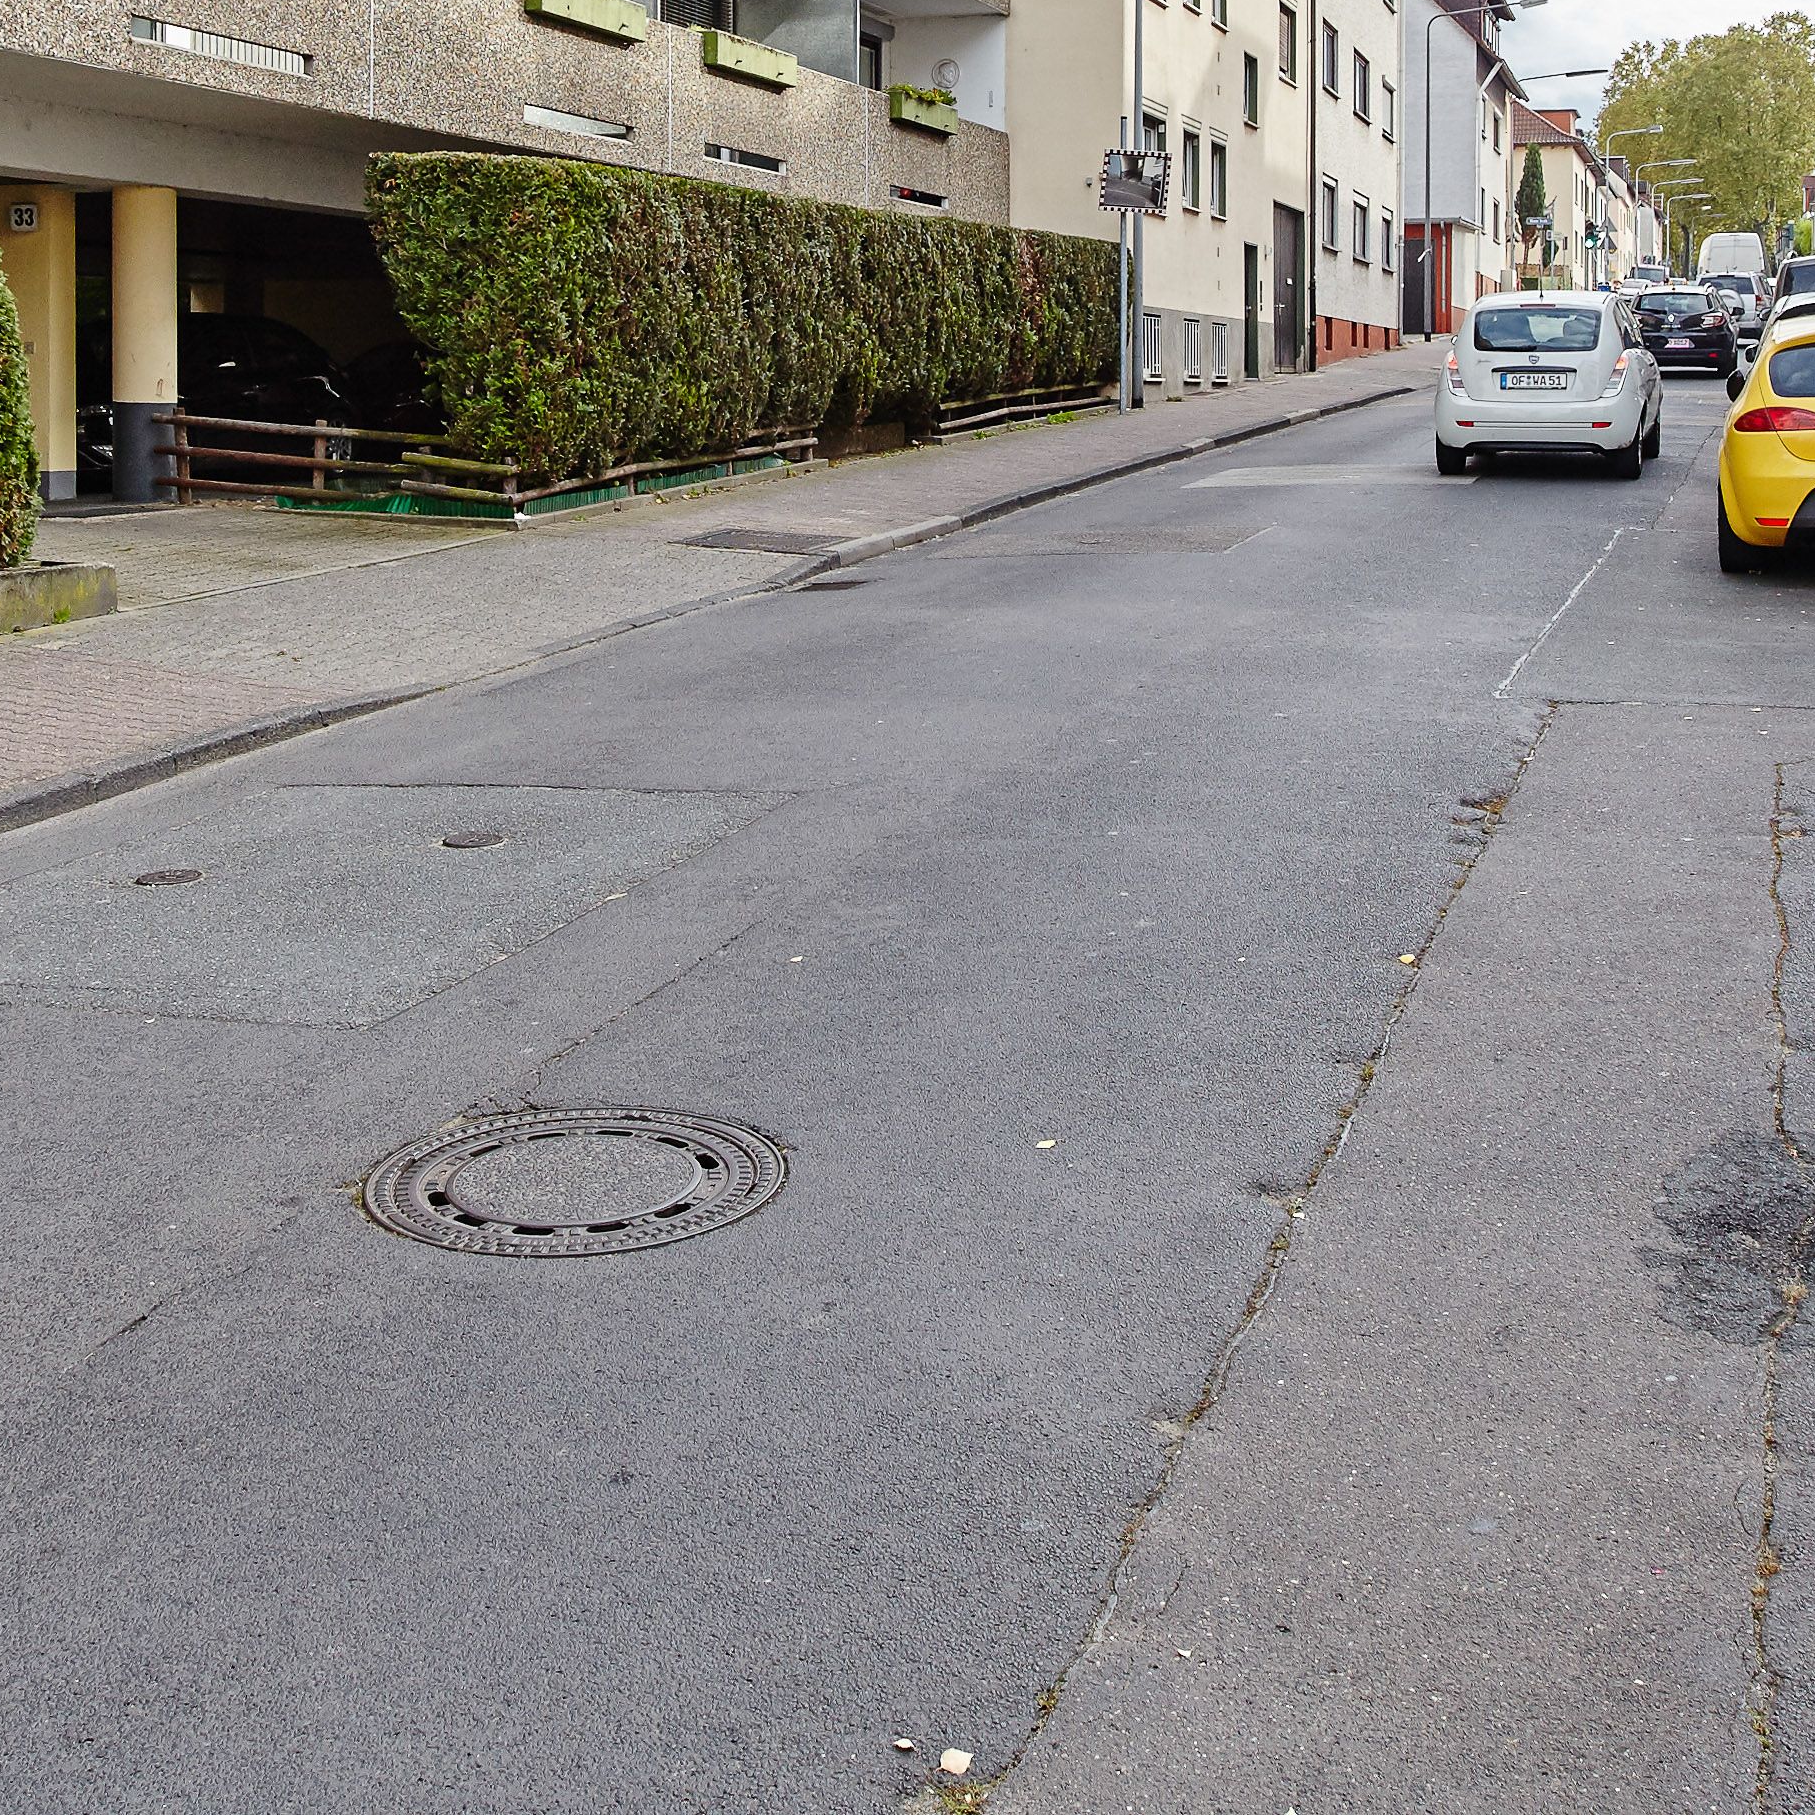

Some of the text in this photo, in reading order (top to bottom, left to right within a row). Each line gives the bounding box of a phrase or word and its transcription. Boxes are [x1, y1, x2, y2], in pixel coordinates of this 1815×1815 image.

[14, 207, 35, 227] 33
[1511, 375, 1525, 386] OF
[1548, 375, 1562, 386] 51
